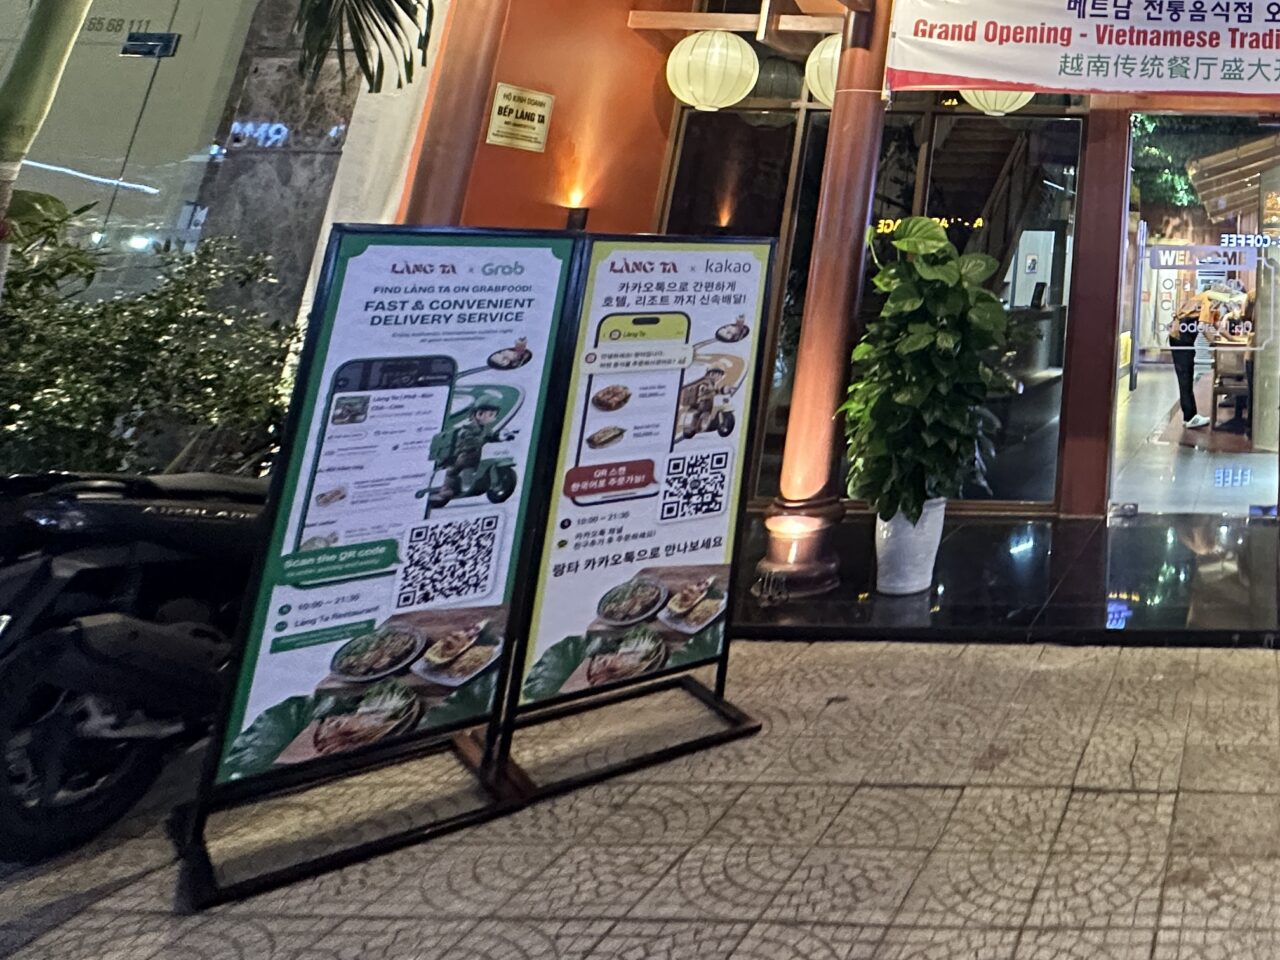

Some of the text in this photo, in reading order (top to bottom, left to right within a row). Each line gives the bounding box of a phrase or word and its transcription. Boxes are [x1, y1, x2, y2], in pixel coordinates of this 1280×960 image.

[913, 18, 978, 43] Grand
[983, 20, 1072, 47] Opening
[1095, 23, 1221, 49] Vietnamese
[390, 259, 434, 275] LÀNG
[439, 263, 458, 275] TA
[481, 260, 525, 277] Grab
[609, 257, 655, 274] LÀNG
[659, 261, 679, 274] TA
[704, 258, 752, 273] kakao
[373, 283, 532, 295] FIND LÀNG TA ON GRABFOOD!
[618, 280, 737, 294] 카카오톡으로 간편하게
[364, 297, 535, 312] FAST & CONVENIENT
[635, 294, 671, 307] 리조트
[673, 294, 696, 306] 까지
[699, 293, 747, 306] 신속배달!
[370, 311, 524, 327] DELIVERY SERVICE
[286, 556, 314, 569] Scan
[317, 552, 337, 564] the
[338, 549, 356, 562] QR
[357, 546, 386, 557] code
[553, 536, 723, 578] 랑타 카카오톡으로 만나보세요
